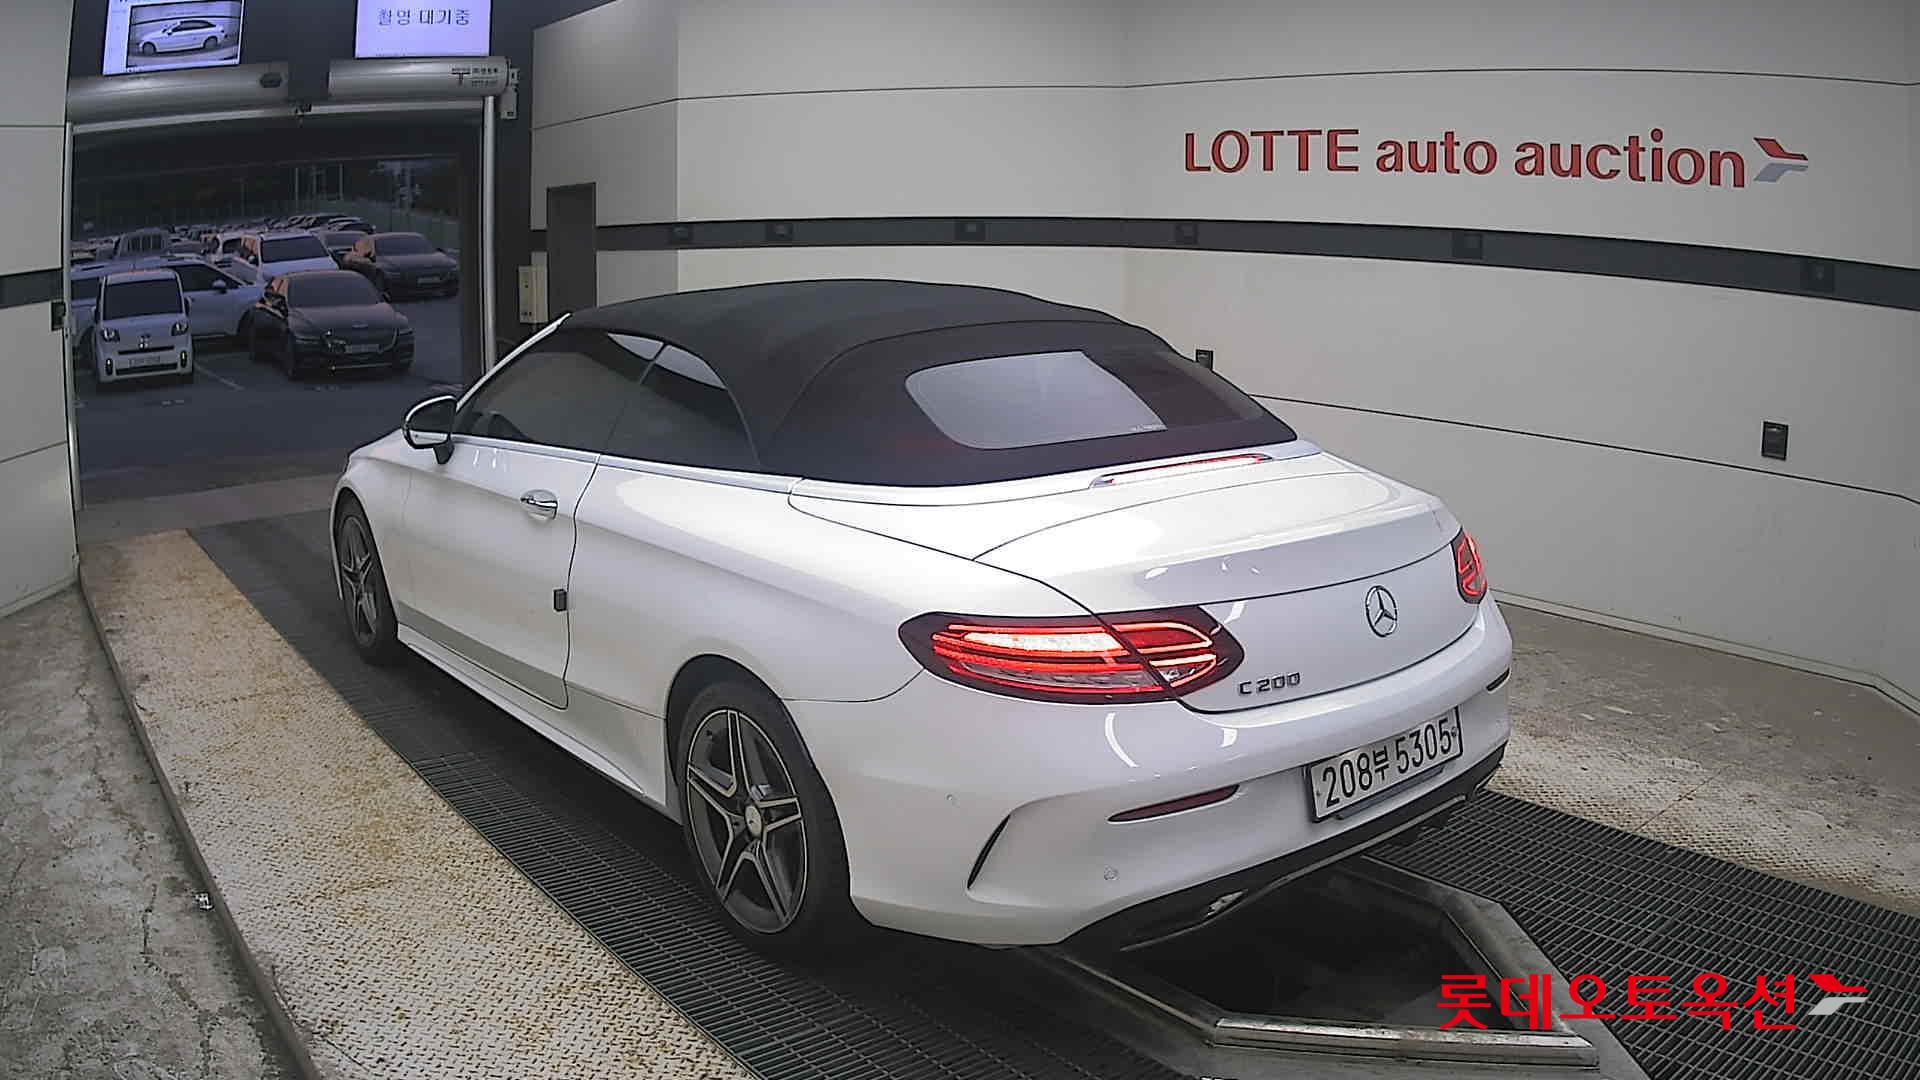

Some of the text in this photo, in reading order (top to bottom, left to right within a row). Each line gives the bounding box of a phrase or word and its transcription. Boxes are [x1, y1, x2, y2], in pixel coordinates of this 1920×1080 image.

[419, 8, 471, 26] 대기중
[1184, 128, 1746, 188] LOTTE auto auction
[1239, 672, 1301, 696] C 200
[1395, 717, 1451, 775] 5305
